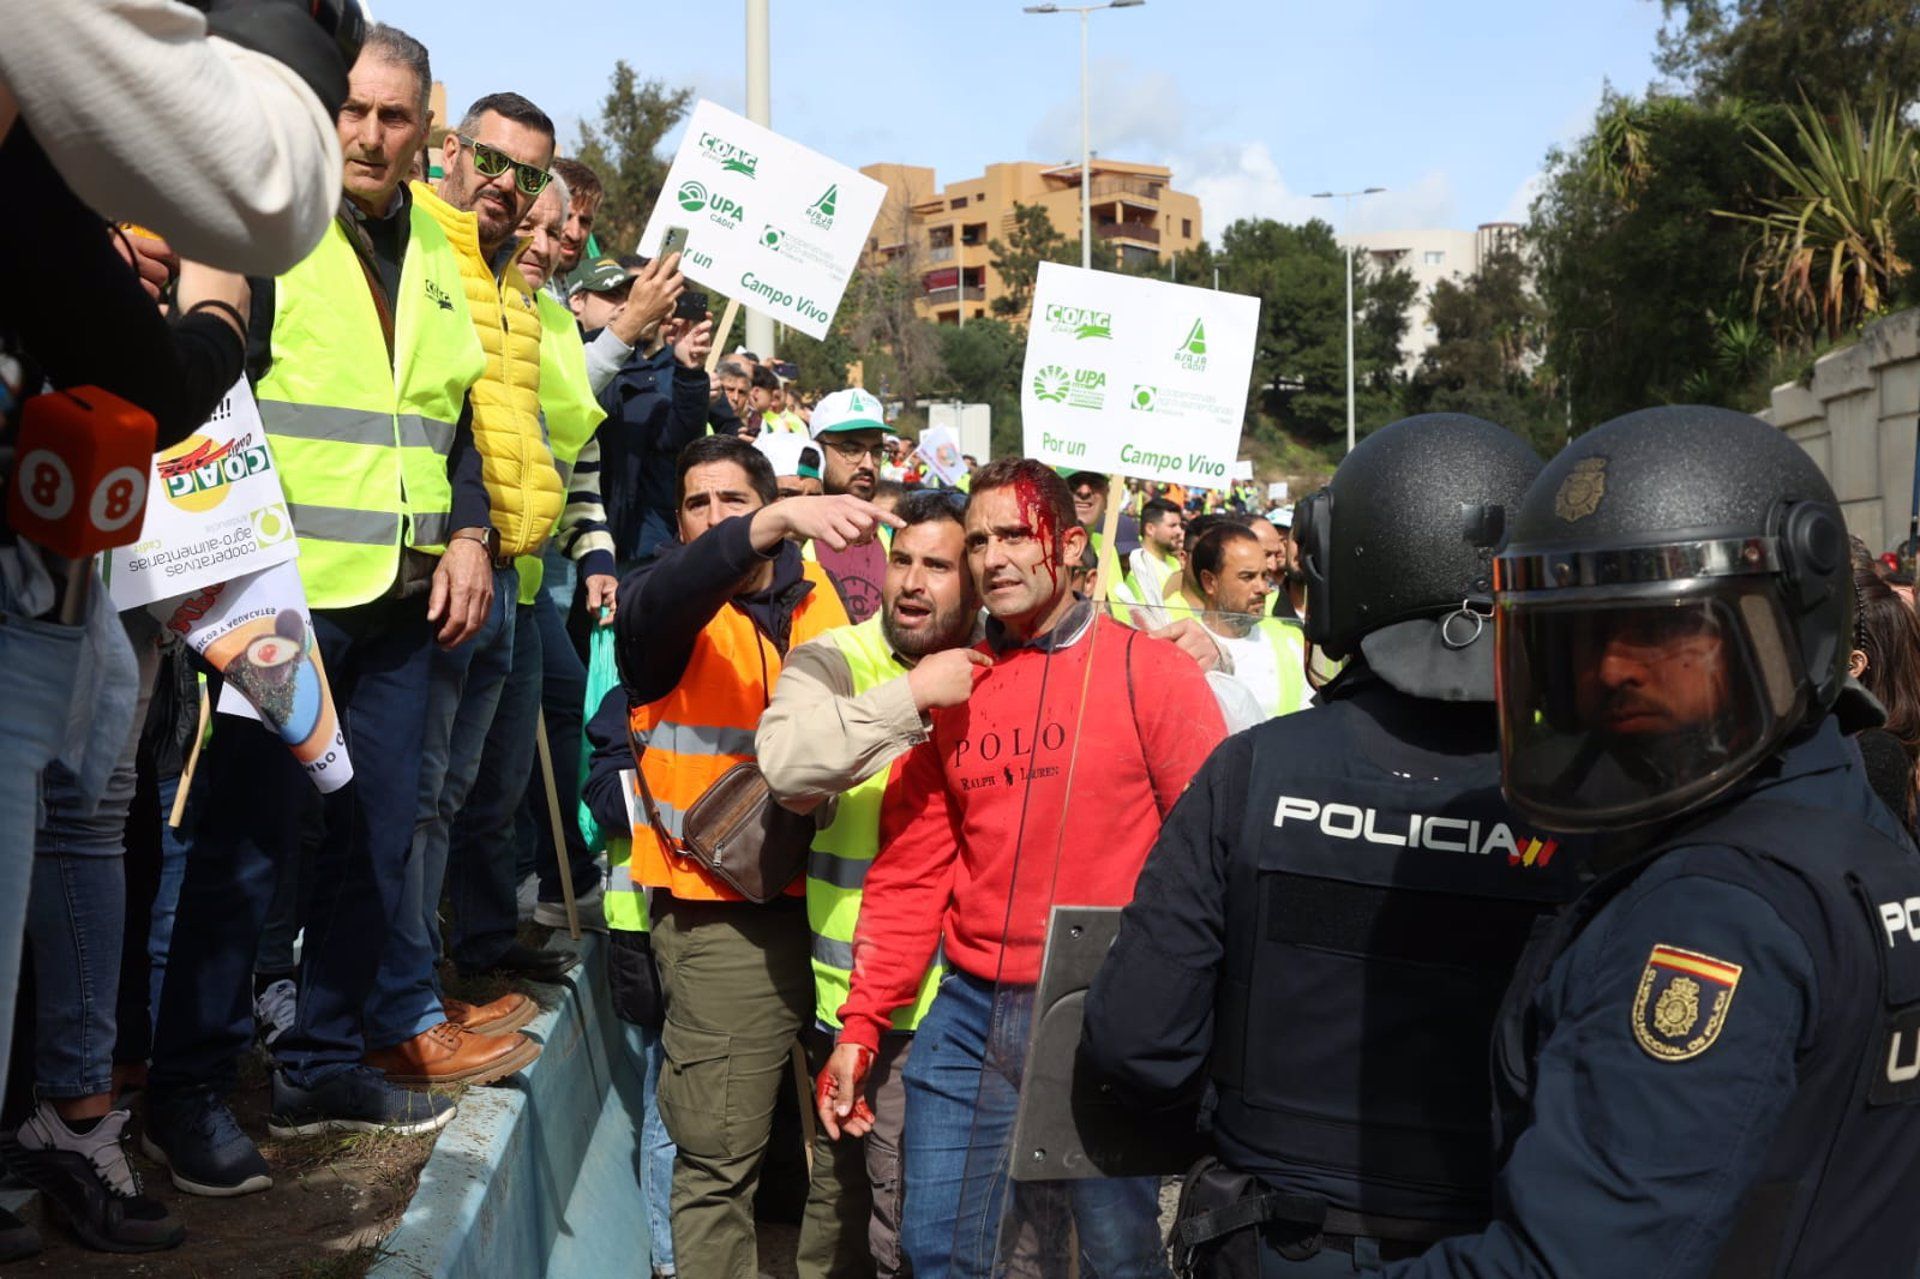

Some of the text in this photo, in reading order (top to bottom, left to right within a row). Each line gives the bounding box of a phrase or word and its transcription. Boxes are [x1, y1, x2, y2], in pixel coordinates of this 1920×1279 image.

[699, 132, 759, 168] COAG
[710, 193, 745, 223] UPA
[694, 253, 714, 270] un
[740, 271, 829, 324] Campo Vivo
[1046, 303, 1112, 328] COAG
[1074, 368, 1106, 388] UPA
[1042, 432, 1087, 457] Por un
[1120, 444, 1226, 478] Campo Vivo
[30, 462, 61, 507] 8
[168, 444, 272, 499] COAG
[104, 478, 134, 520] 8
[165, 540, 257, 578] cooperativas
[953, 722, 1066, 769] POLO
[960, 775, 996, 792] RALPH
[1273, 795, 1521, 858] POLICIA
